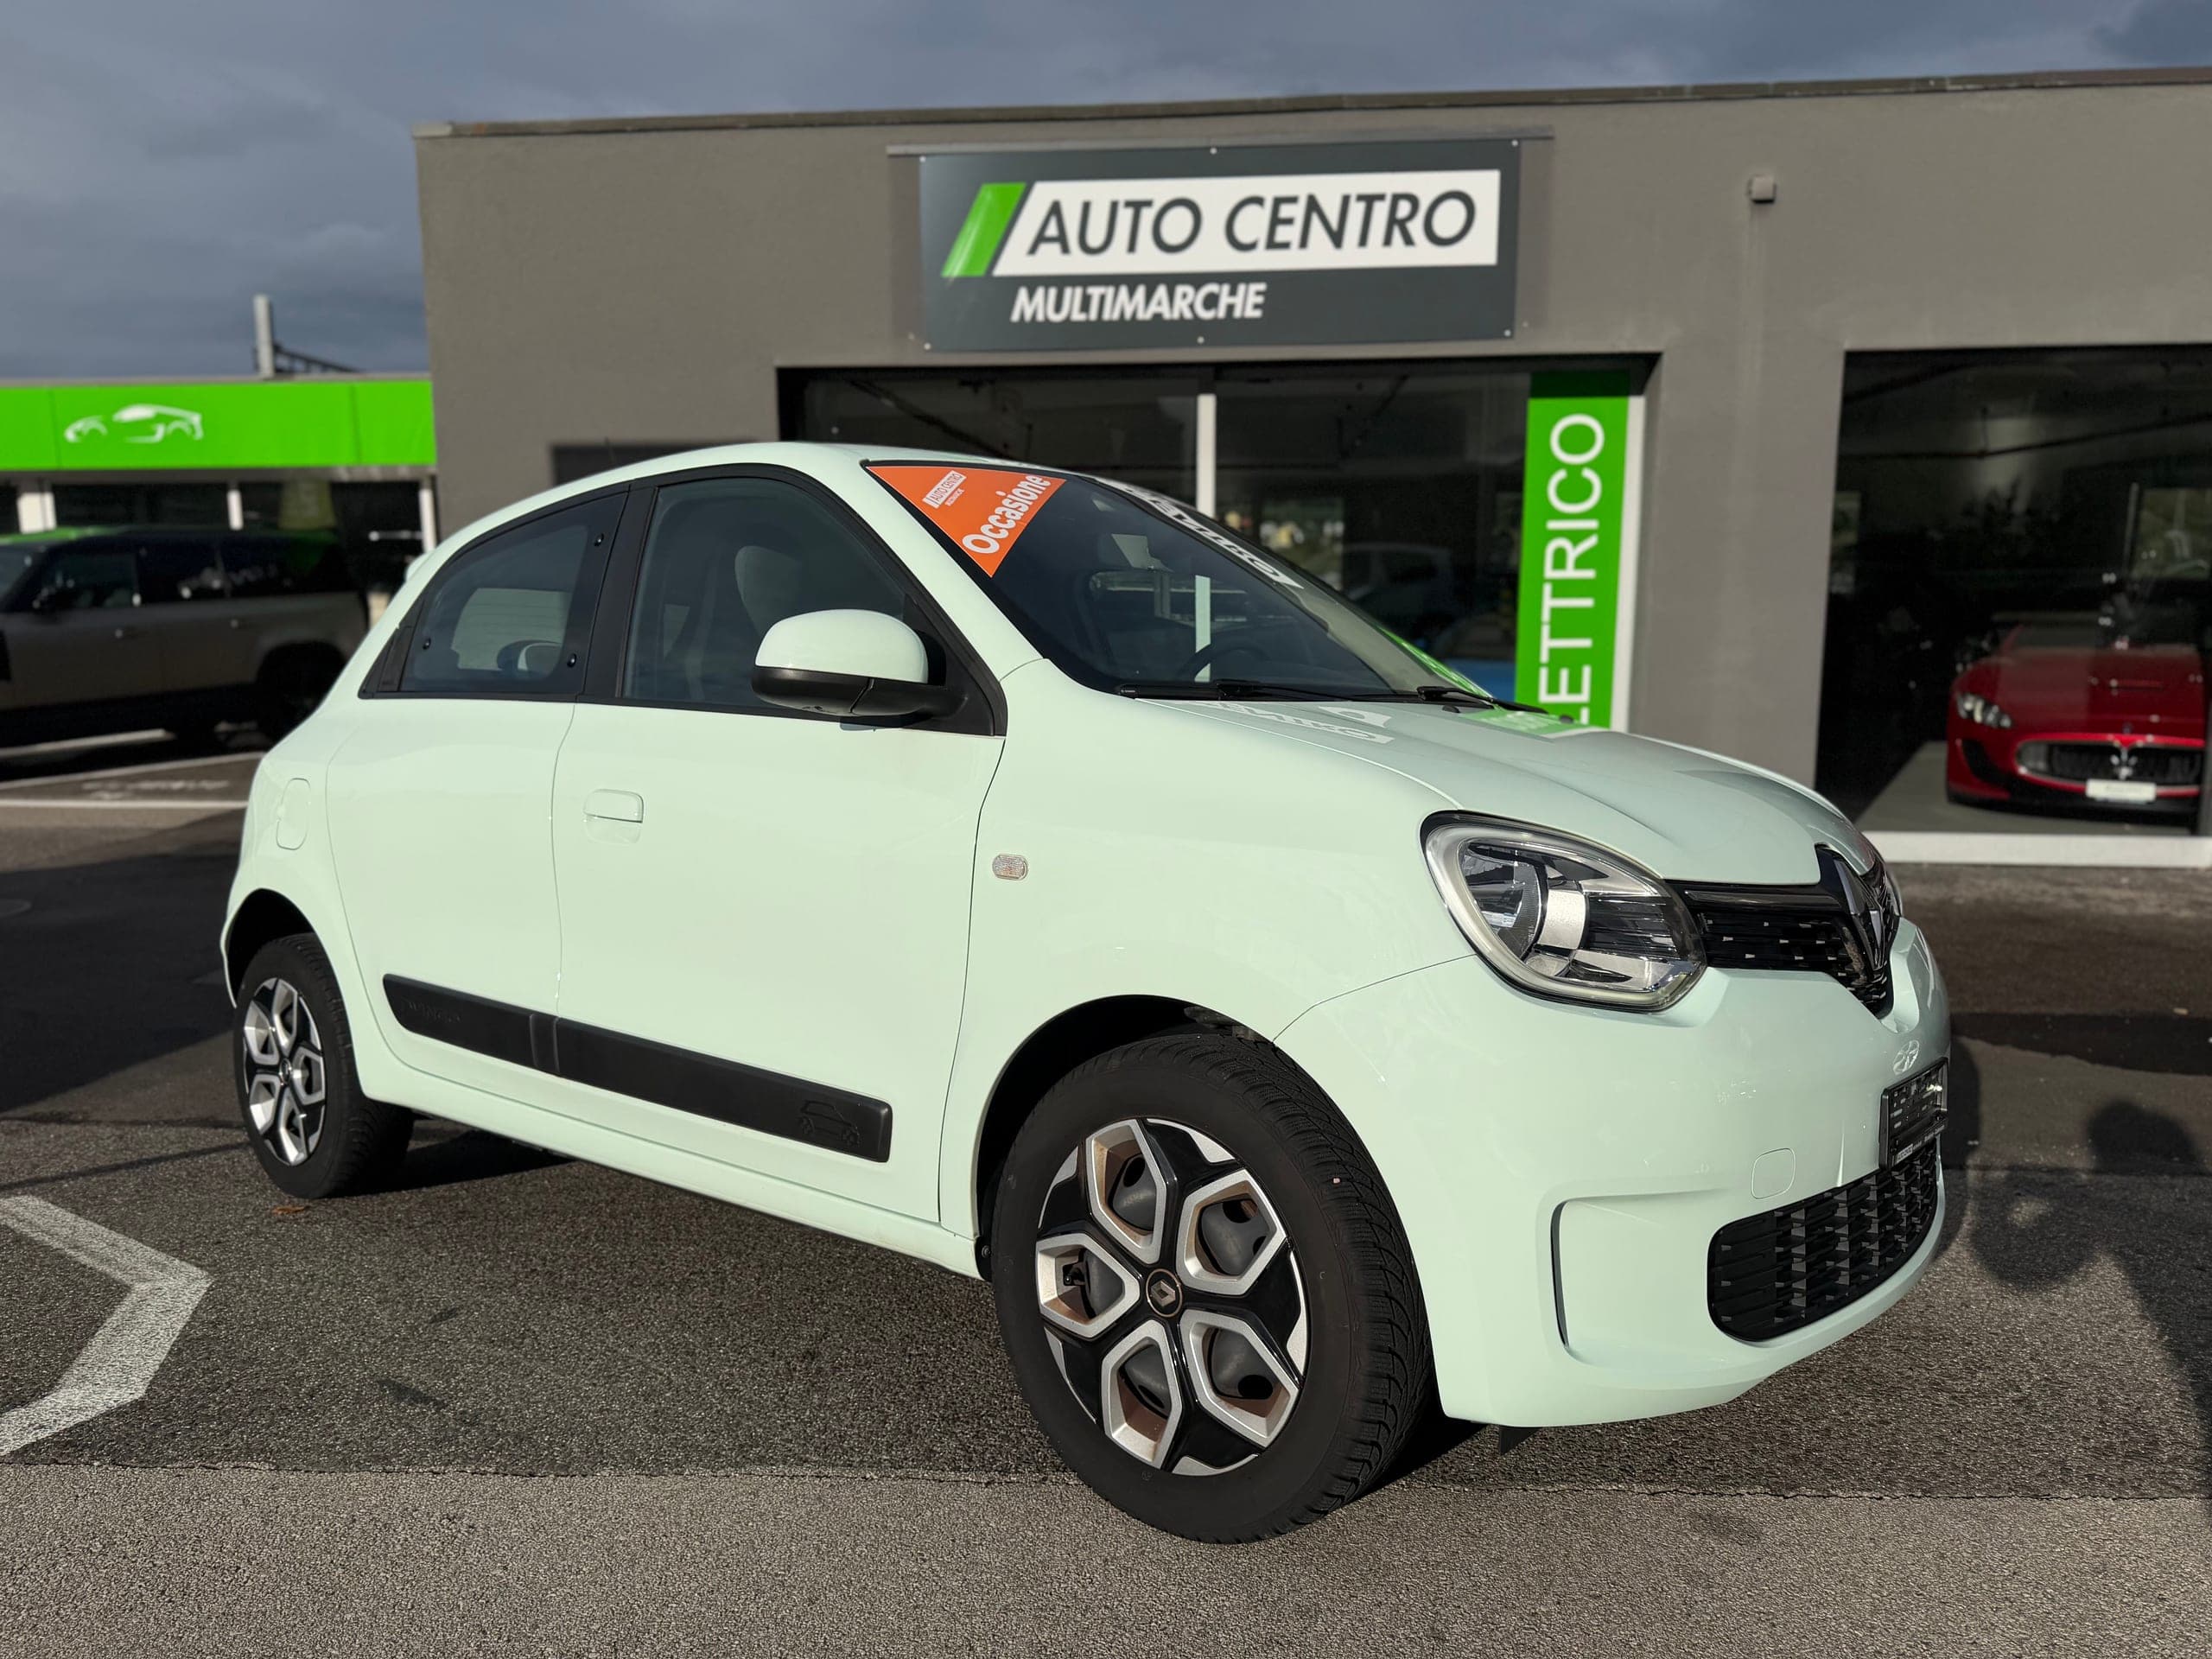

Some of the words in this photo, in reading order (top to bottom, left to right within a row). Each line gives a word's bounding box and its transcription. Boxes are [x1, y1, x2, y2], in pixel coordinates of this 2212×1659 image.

[1027, 197, 1202, 256] AUTO
[1224, 190, 1476, 252] CENTRO
[1010, 282, 1268, 323] MULTIMARCHE
[962, 474, 1052, 554] Occasione
[1538, 413, 1605, 726] ETTRICO
